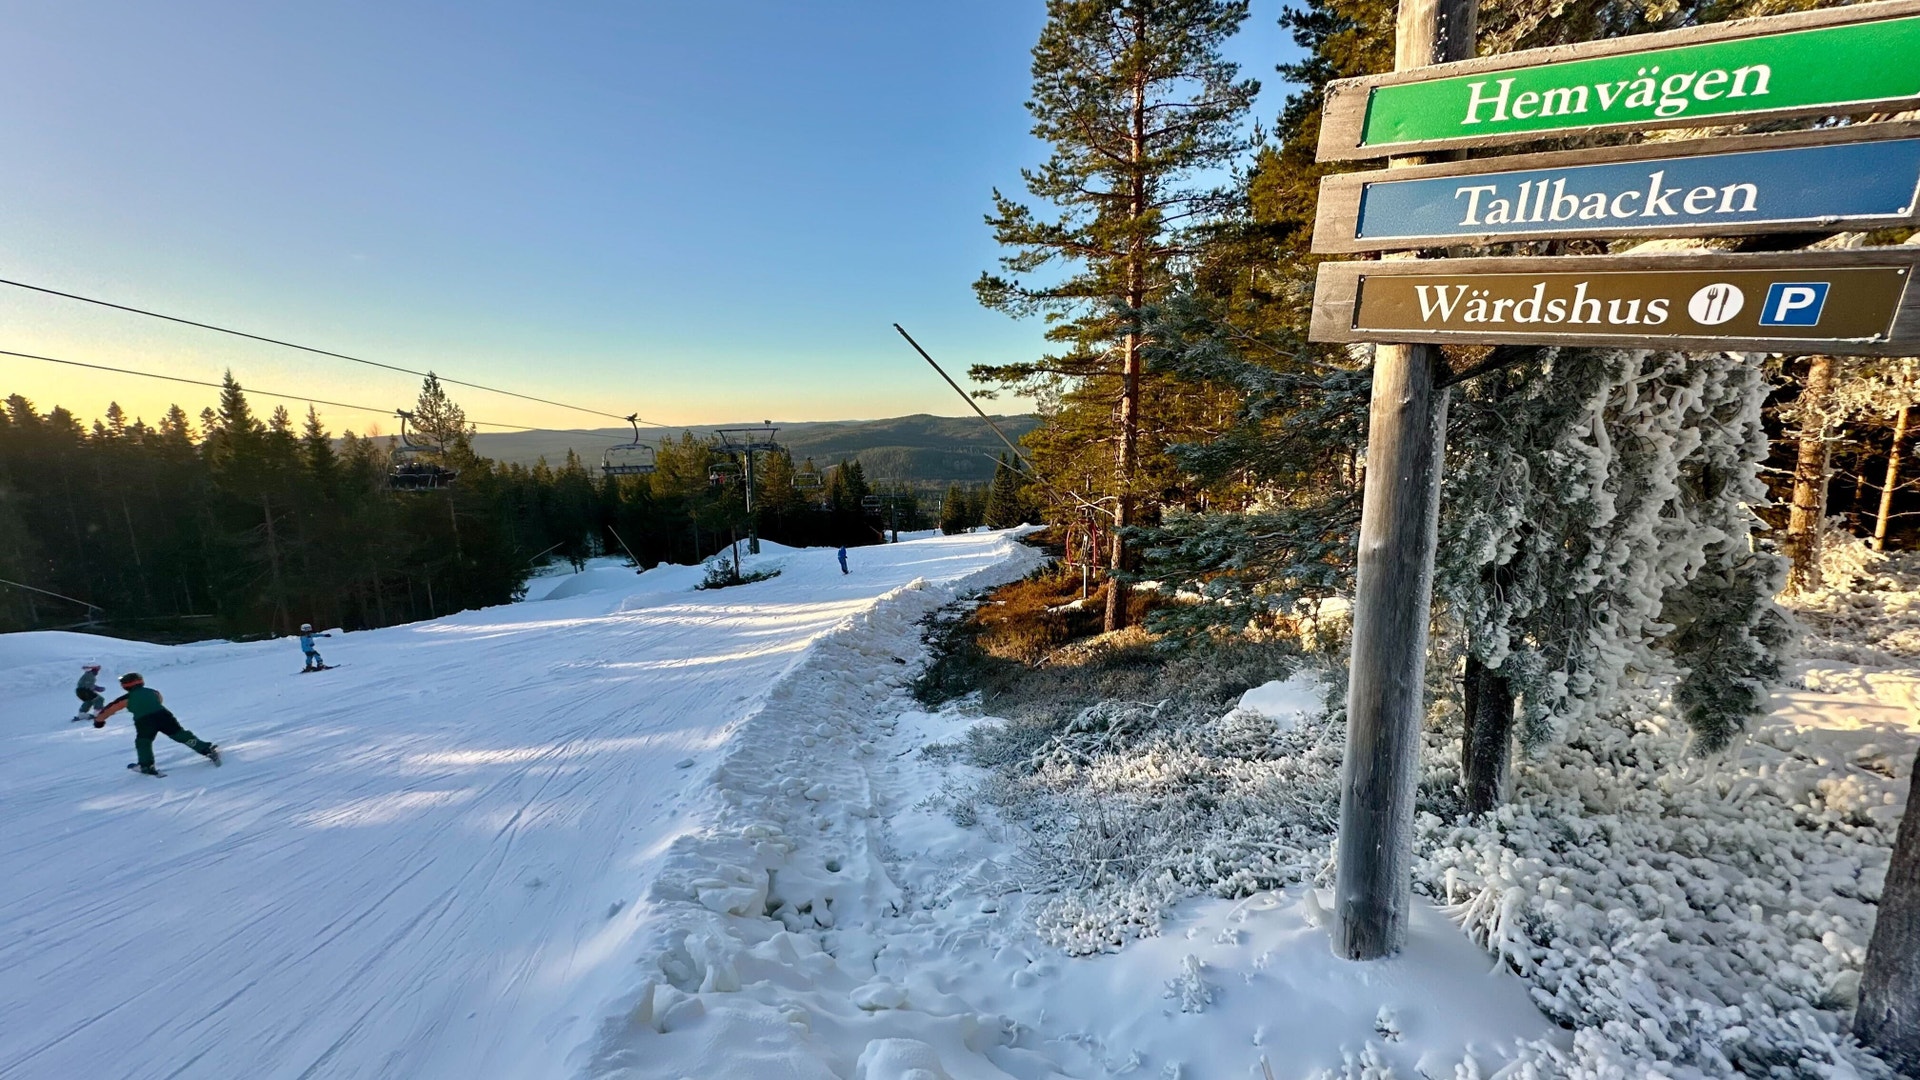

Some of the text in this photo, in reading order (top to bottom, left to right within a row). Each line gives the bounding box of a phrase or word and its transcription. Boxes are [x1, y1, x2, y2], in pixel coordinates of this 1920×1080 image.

[1461, 65, 1771, 124] Hemvägen
[1454, 170, 1758, 227] Tallbacken
[1415, 281, 1816, 325] Wärdshus P
